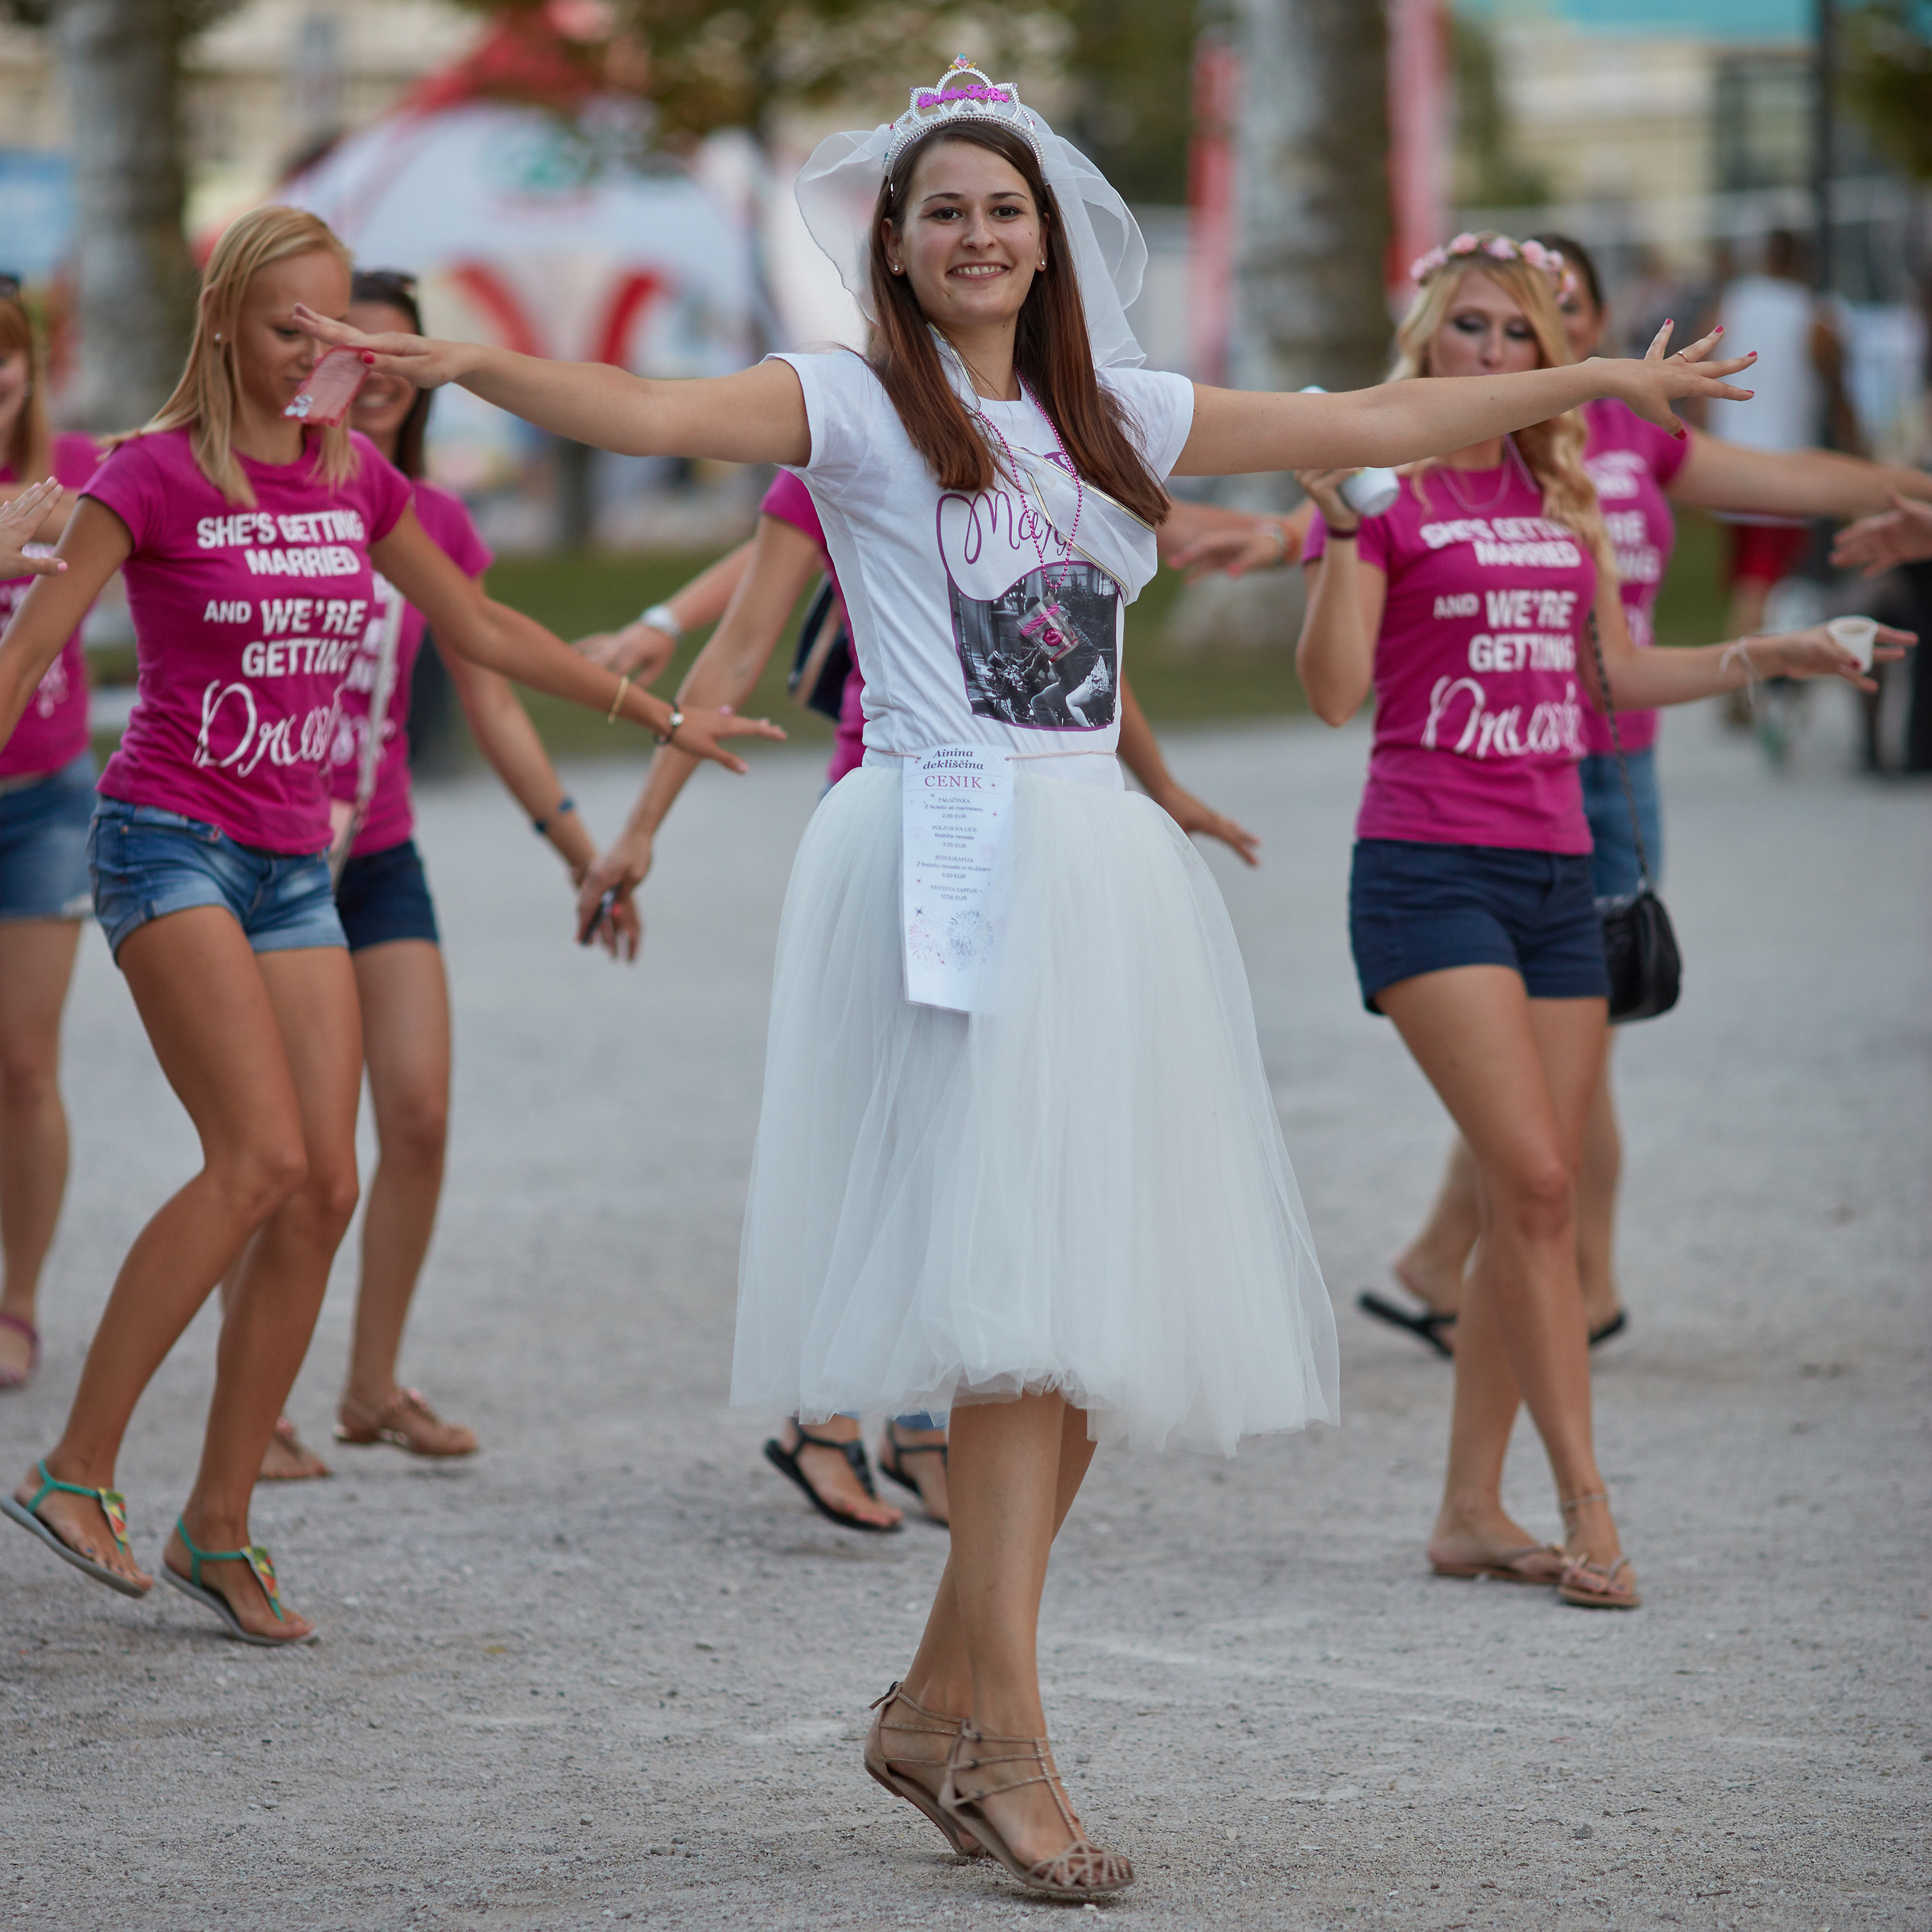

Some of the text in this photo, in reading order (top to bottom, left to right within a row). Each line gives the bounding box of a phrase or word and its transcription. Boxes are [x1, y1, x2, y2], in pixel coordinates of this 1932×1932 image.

[196, 511, 278, 549] SHE'S
[244, 546, 361, 577] MARRIED
[1472, 540, 1581, 568] MARRIED
[203, 600, 253, 624] AND
[259, 598, 367, 636] WE'RE
[1433, 590, 1577, 629] AND WE'RE
[923, 759, 984, 770] dekliščina
[933, 748, 973, 758] Ainina
[924, 775, 982, 789] CENIK
